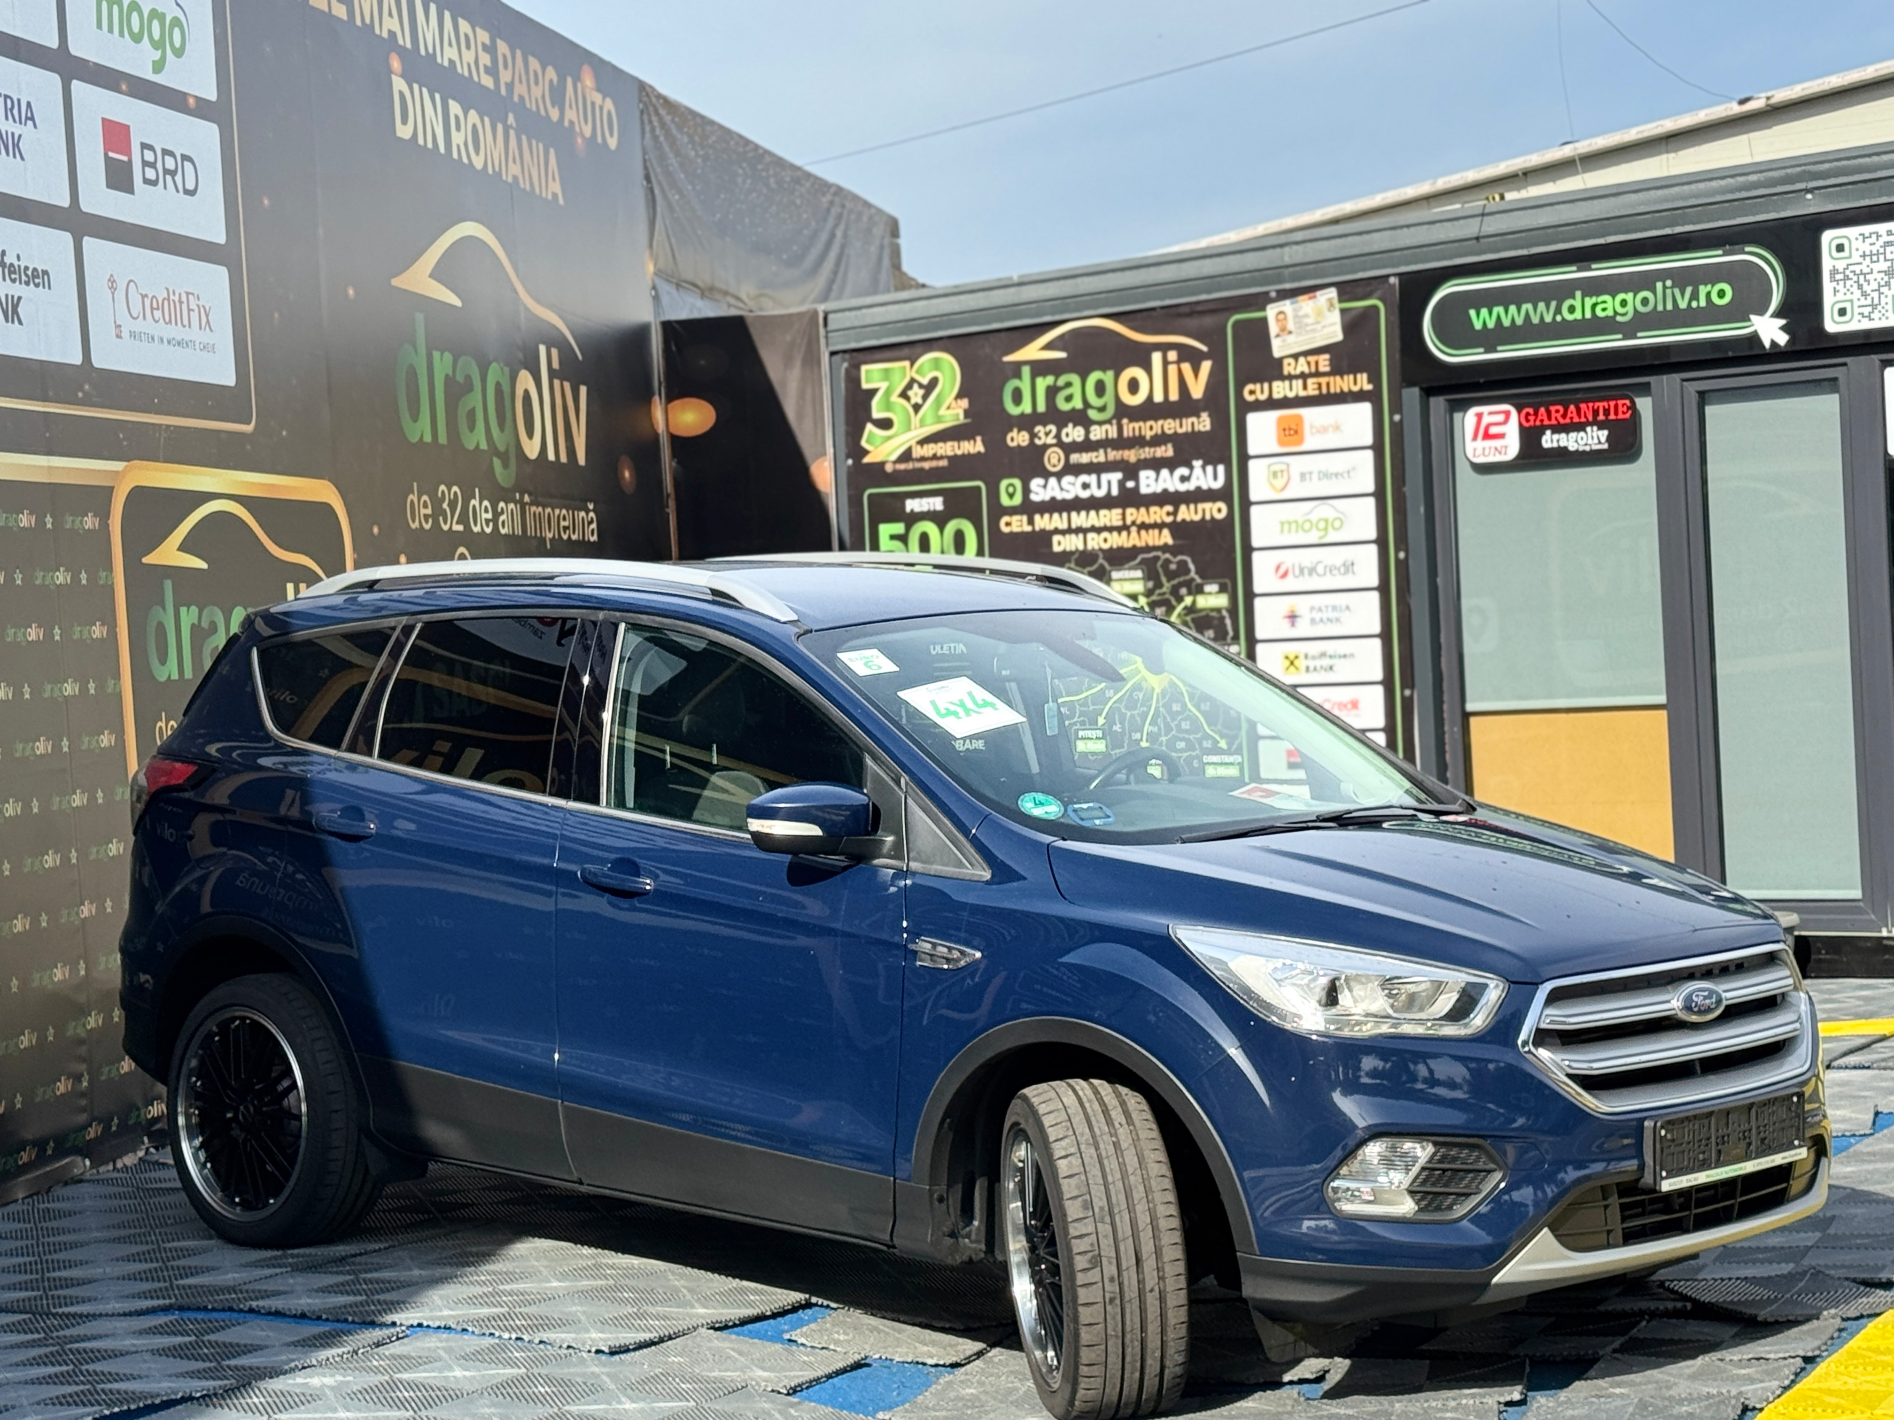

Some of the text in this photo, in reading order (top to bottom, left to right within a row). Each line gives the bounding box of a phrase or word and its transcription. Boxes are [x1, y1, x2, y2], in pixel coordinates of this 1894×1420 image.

[415, 0, 494, 90] MARE
[496, 38, 559, 122] PARC
[564, 76, 618, 150] AUTO
[391, 73, 564, 205] DIN ROMÂNIA
[140, 141, 199, 197] BRD
[125, 278, 213, 333] CreditFix
[1469, 279, 1733, 331] www.dragoliv.ro
[129, 330, 216, 354] PRIETEN IN MOMENTE CHEIE
[1283, 354, 1331, 375] RATE
[1002, 350, 1213, 421] dragoliv
[1243, 373, 1374, 401] CU BULETINUL
[396, 312, 587, 488] dragoliv
[860, 351, 961, 451] 32
[1519, 399, 1633, 428] GARANTIE
[1006, 412, 1211, 447] de 32 de ani împreună
[1282, 420, 1343, 438] tbi bank
[1471, 410, 1512, 442] 12
[1541, 425, 1609, 451] dragoliv
[1069, 449, 1105, 464] marcă
[1107, 443, 1174, 463] înregistrată
[1472, 445, 1509, 459] LUNI
[1029, 472, 1123, 502] SASCUT
[1138, 459, 1225, 494] BACĂU
[1300, 470, 1314, 483] BT
[407, 482, 598, 549] de 32 de ani împreună
[905, 497, 944, 513] PESTE
[1000, 501, 1228, 533] CEL MAI MARE PARC AUTO
[878, 517, 978, 556] 500
[1052, 526, 1174, 552] DIN ROMÂNIA
[1279, 515, 1344, 541] mogo
[1292, 559, 1356, 579] UniCredit
[1309, 604, 1351, 614] PATRIA
[1310, 616, 1342, 627] BANK
[863, 660, 882, 671] 6
[1692, 990, 1716, 1012] Ford
